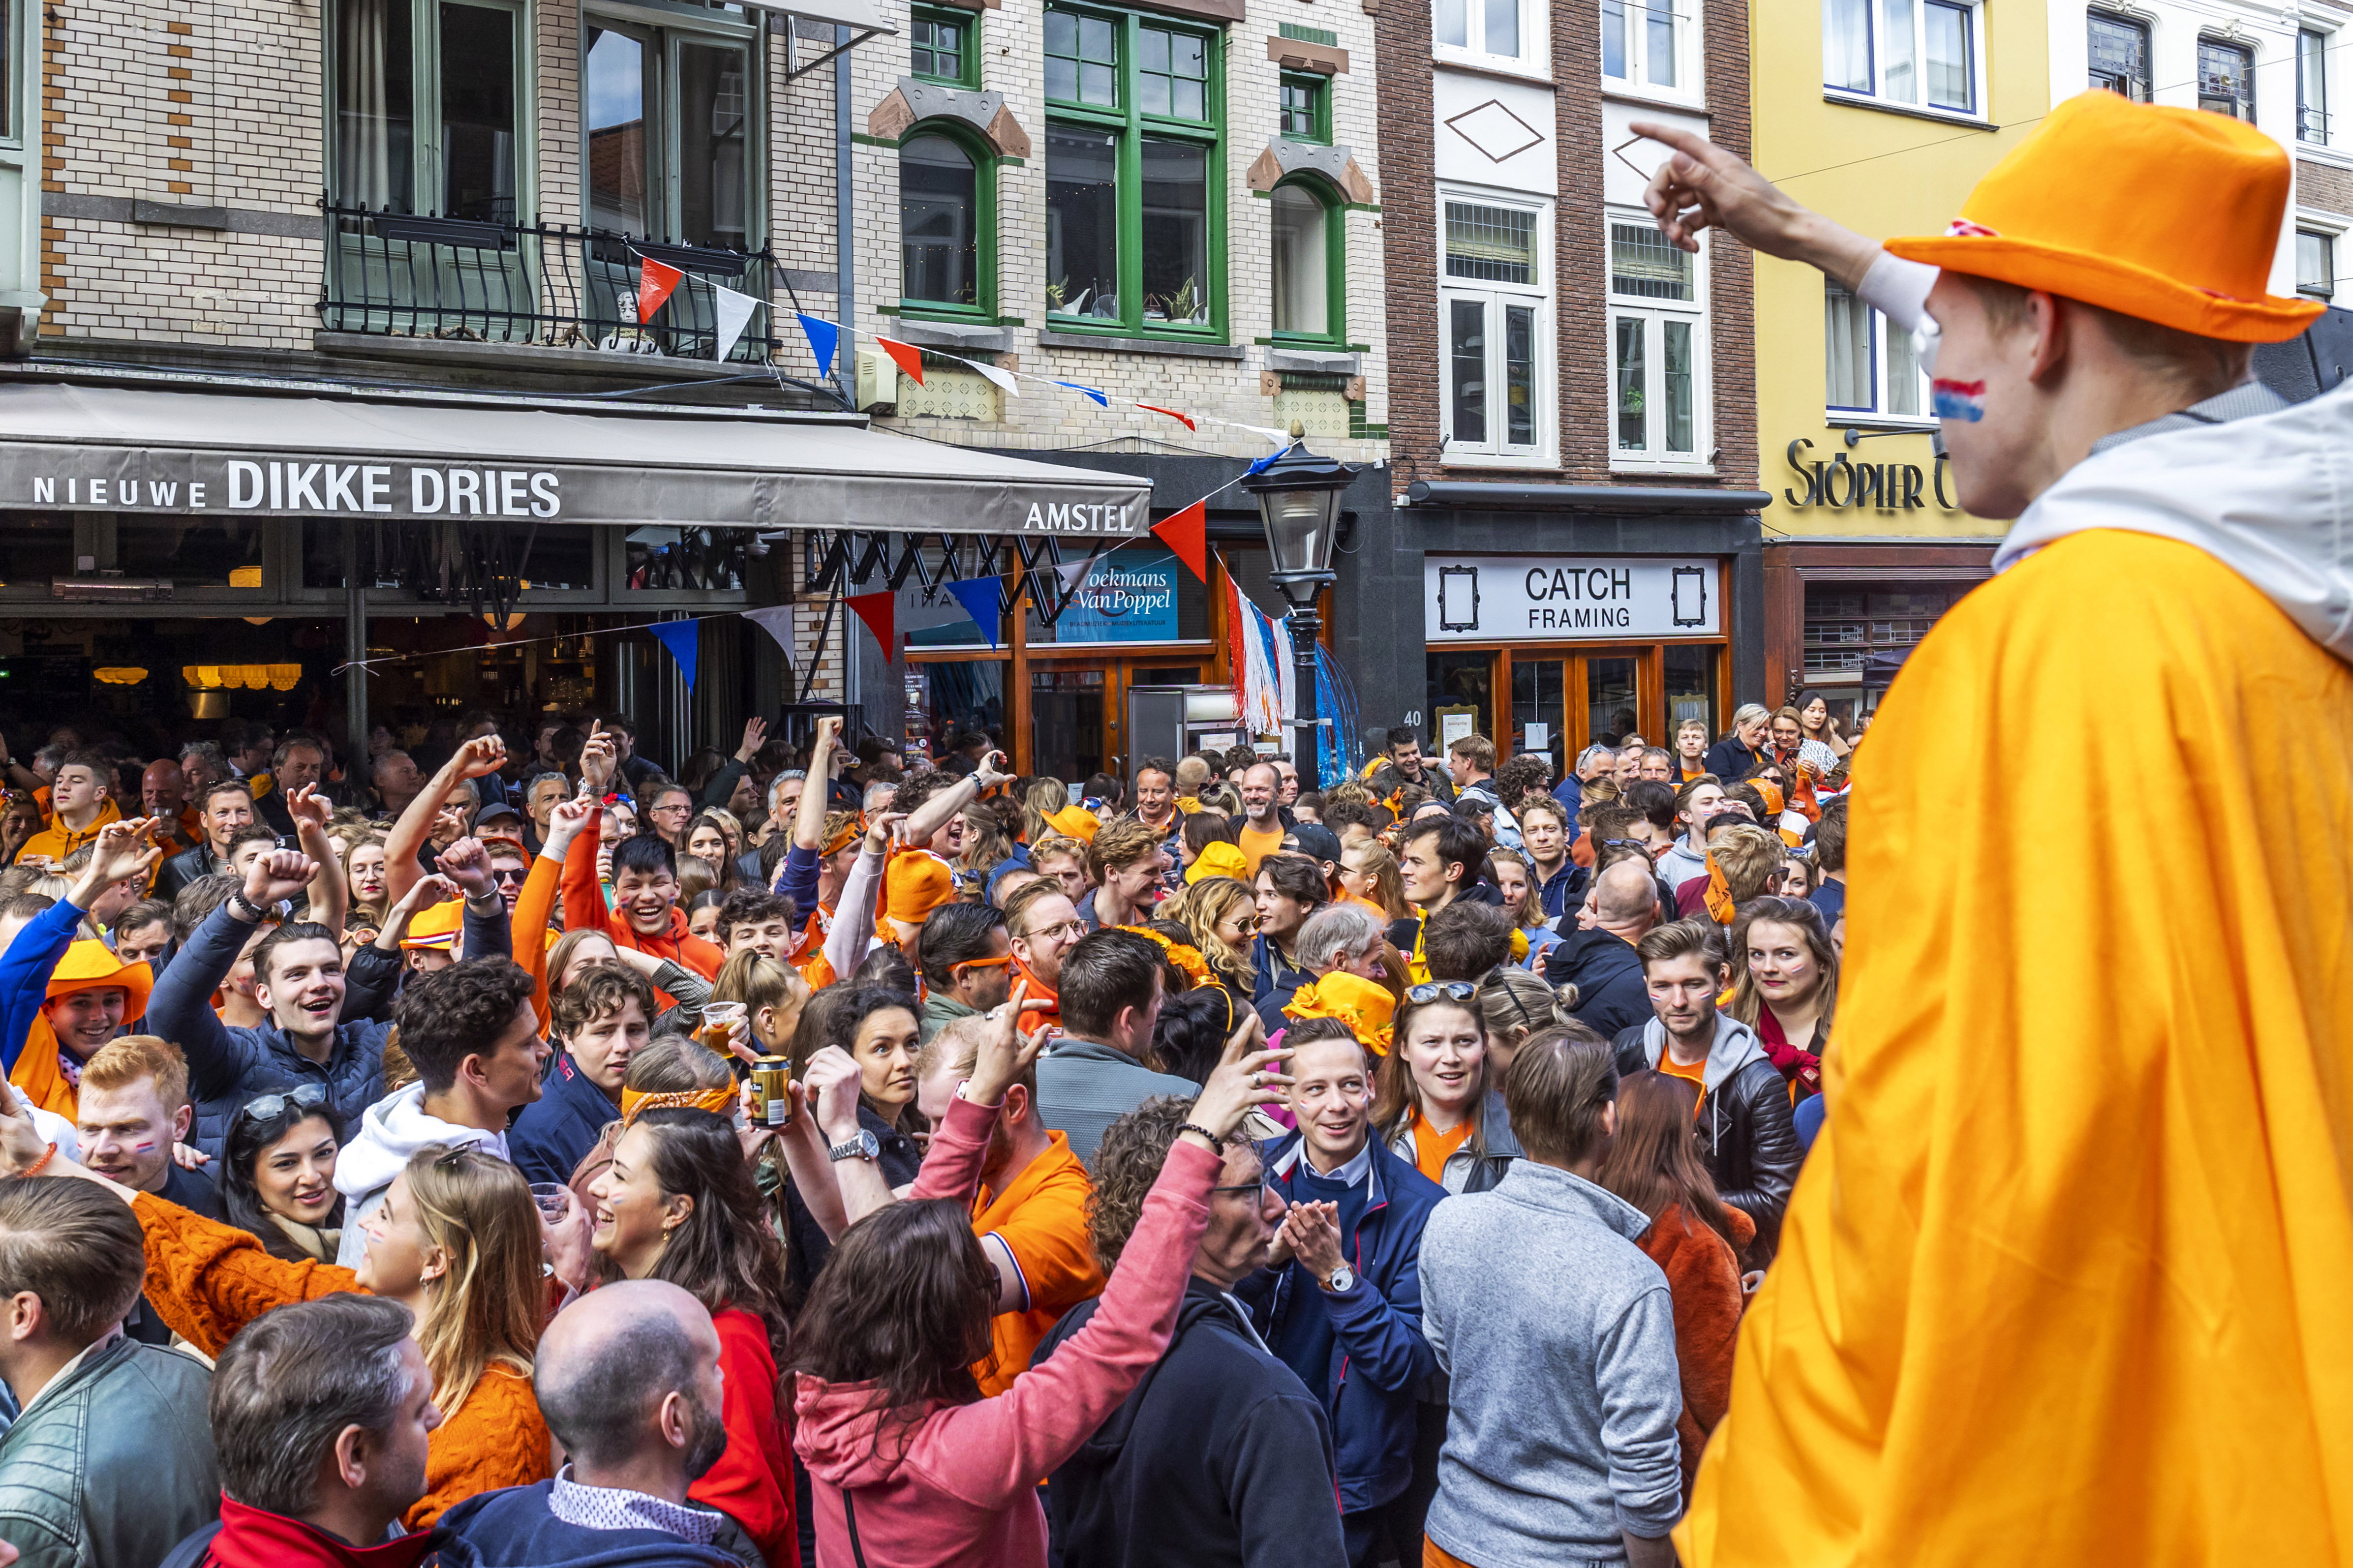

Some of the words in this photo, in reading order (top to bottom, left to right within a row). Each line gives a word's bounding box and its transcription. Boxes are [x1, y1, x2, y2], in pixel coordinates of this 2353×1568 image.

[33, 476, 207, 509] NIEUWE
[227, 459, 393, 513] DIKKE
[411, 467, 561, 518] DRIES
[1088, 568, 1167, 587] oekmans
[1526, 568, 1630, 601] CATCH
[1074, 590, 1111, 609] Van
[1113, 589, 1170, 615] Poppel
[1528, 607, 1629, 629] FRAMING
[1404, 710, 1421, 727] 40
